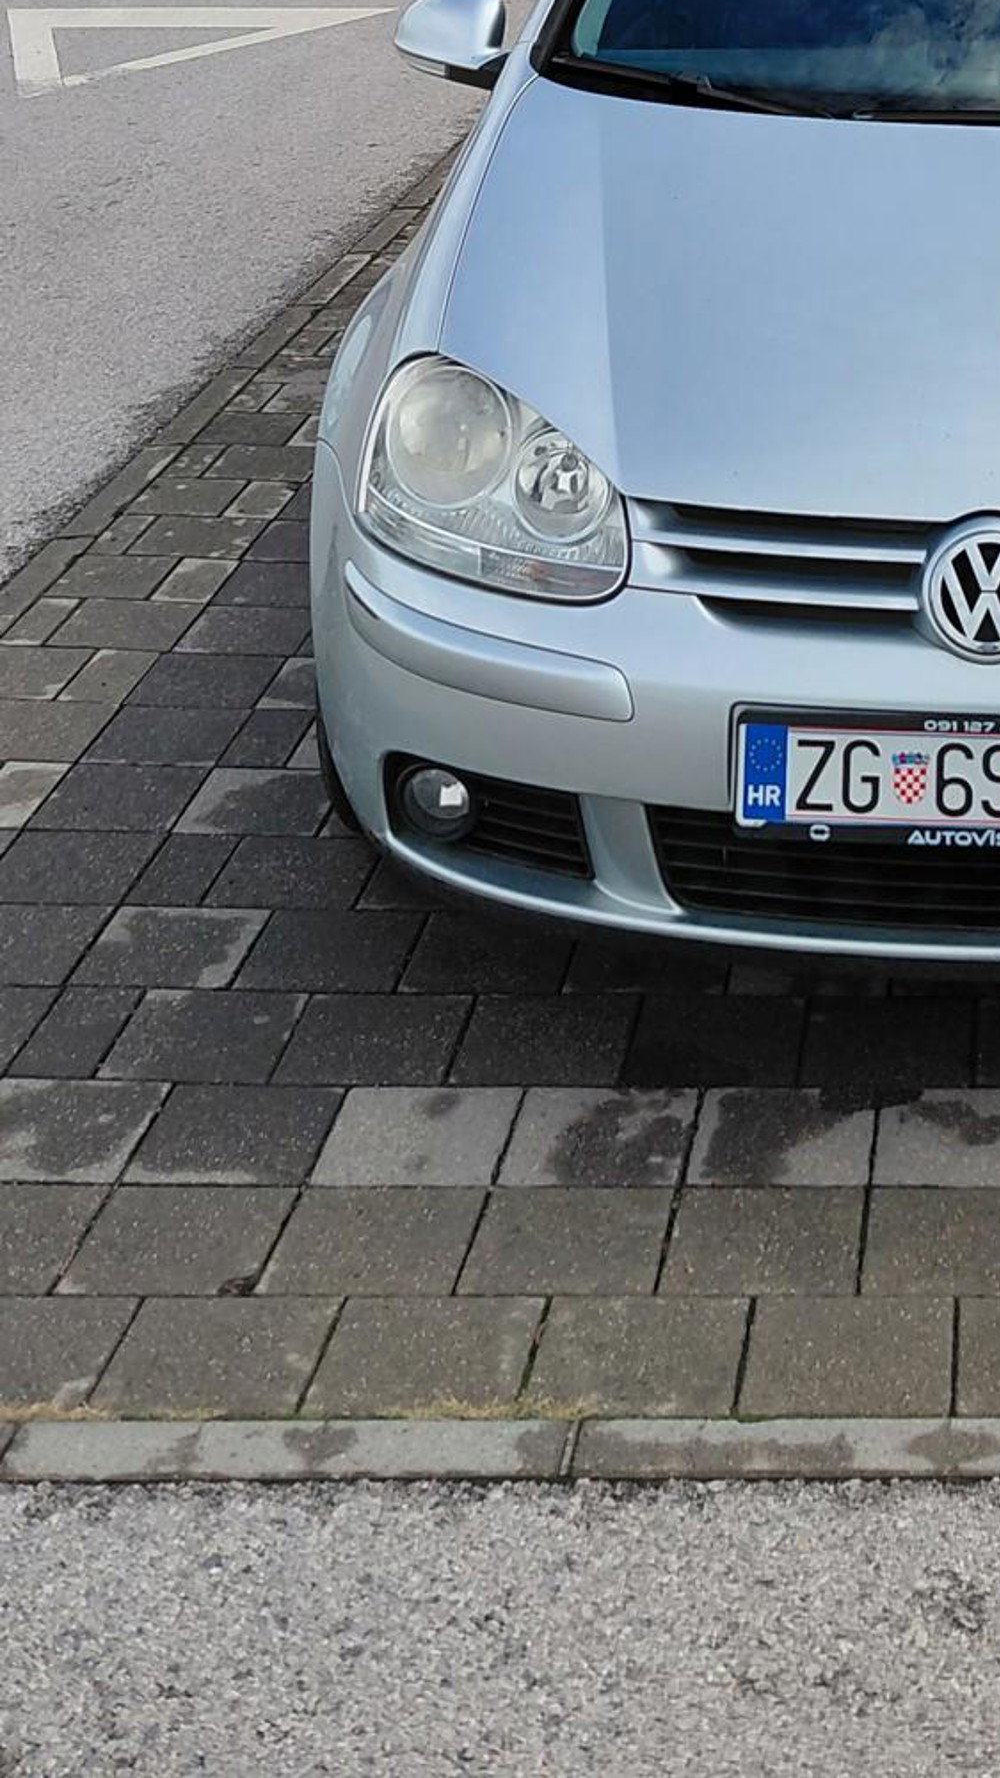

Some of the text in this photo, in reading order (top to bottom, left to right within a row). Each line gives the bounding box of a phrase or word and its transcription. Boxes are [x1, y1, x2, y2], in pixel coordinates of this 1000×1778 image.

[923, 719, 957, 732] 091
[963, 720, 996, 733] 127
[795, 739, 881, 814] ZG
[747, 784, 781, 807] HR
